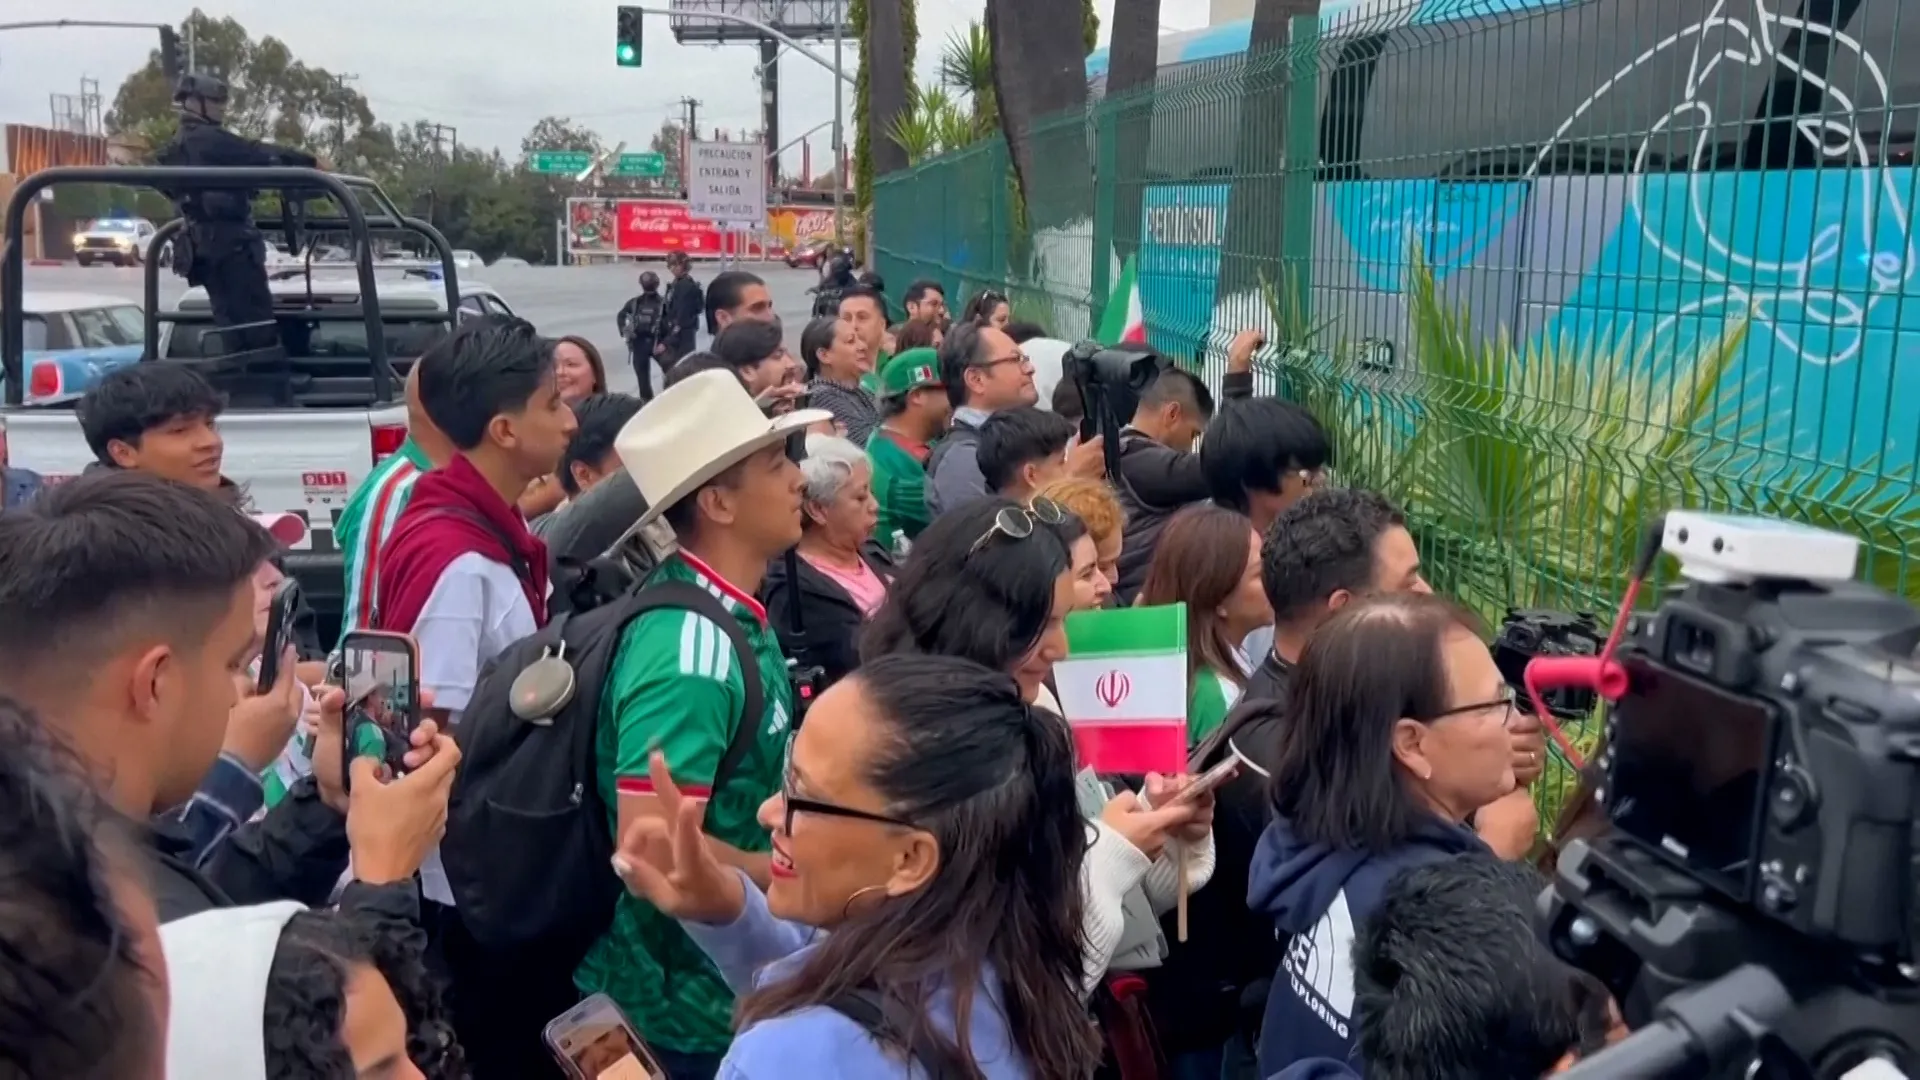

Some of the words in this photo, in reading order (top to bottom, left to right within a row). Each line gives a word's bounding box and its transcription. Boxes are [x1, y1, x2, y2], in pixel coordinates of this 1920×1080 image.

[699, 167, 740, 177] ENTRADA
[745, 169, 752, 179] Y
[708, 185, 741, 196] SALIDA
[305, 474, 344, 485] 911
